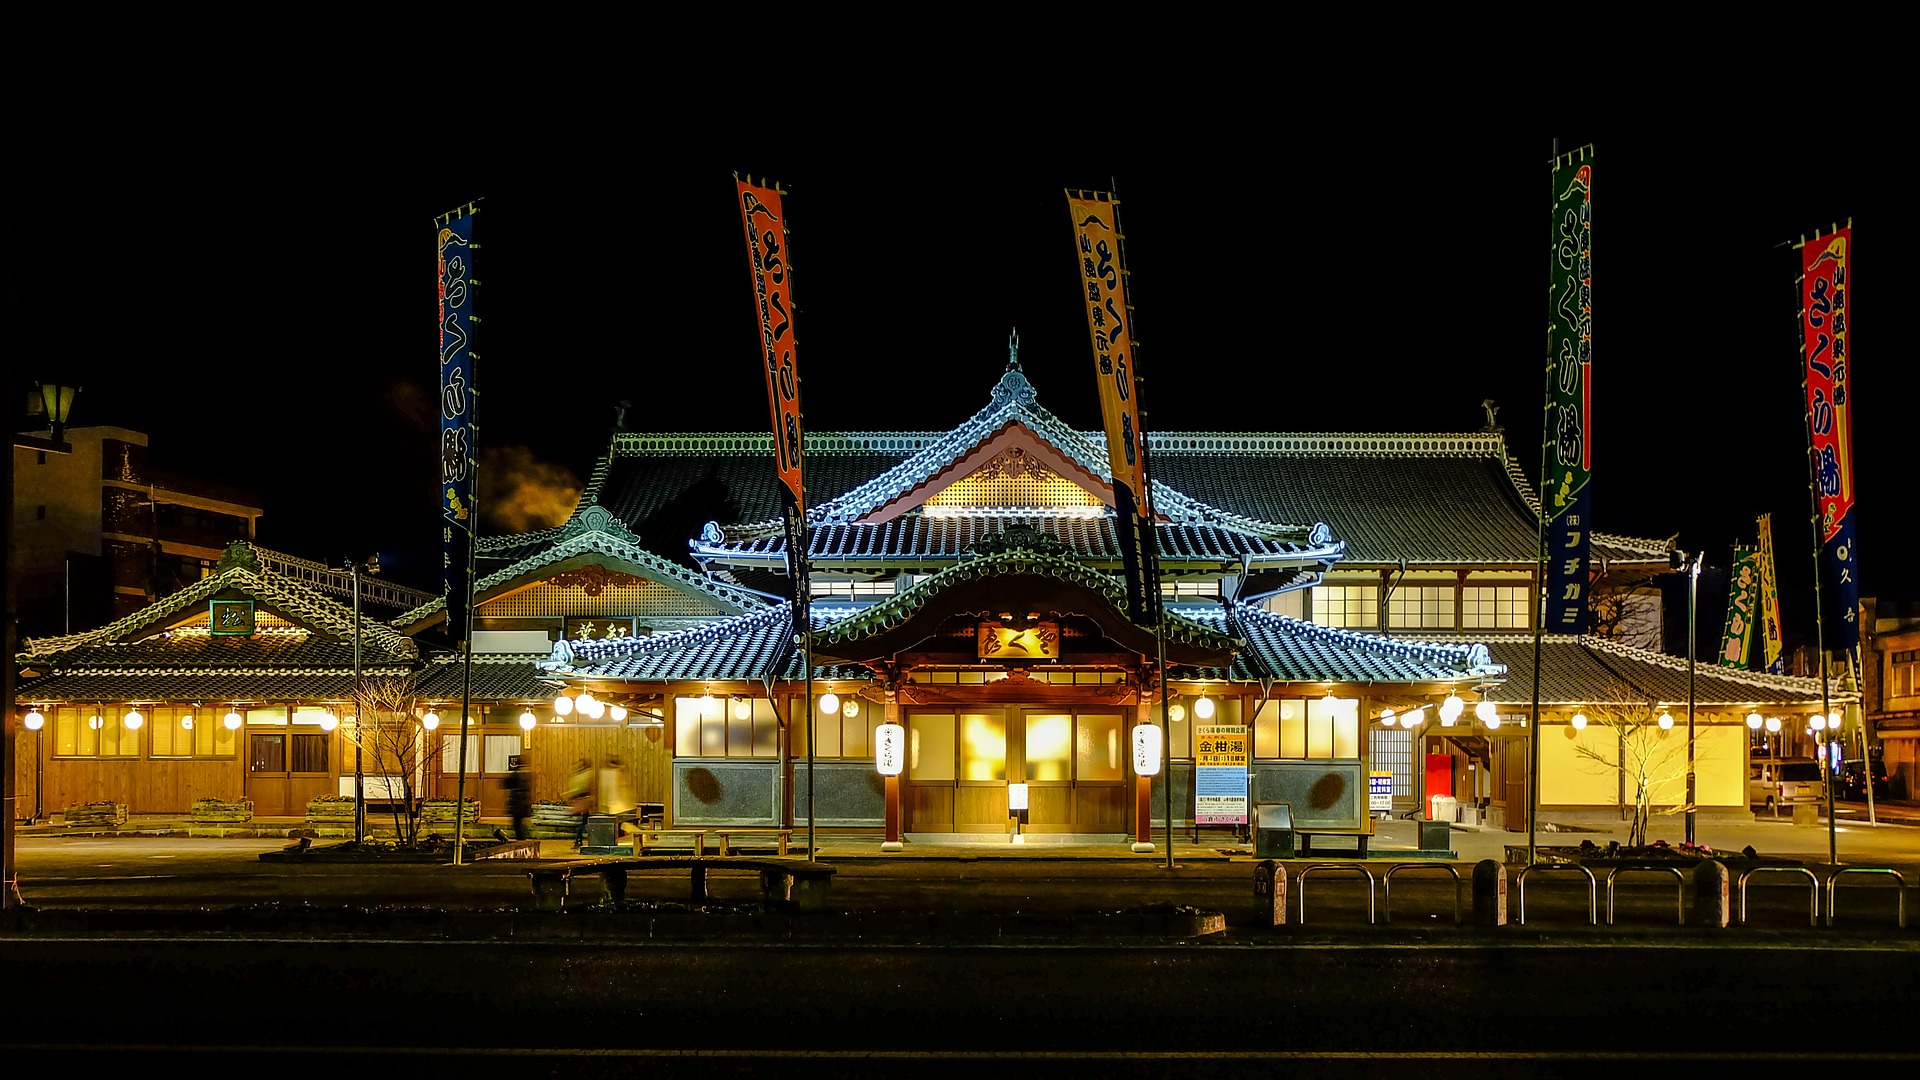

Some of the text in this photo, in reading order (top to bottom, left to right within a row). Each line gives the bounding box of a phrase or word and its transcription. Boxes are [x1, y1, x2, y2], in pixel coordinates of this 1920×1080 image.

[1557, 209, 1581, 466] さくら湯
[1808, 277, 1841, 498] さくら湯
[883, 737, 893, 767] さくら湯
[1200, 741, 1243, 752] 金柑湯
